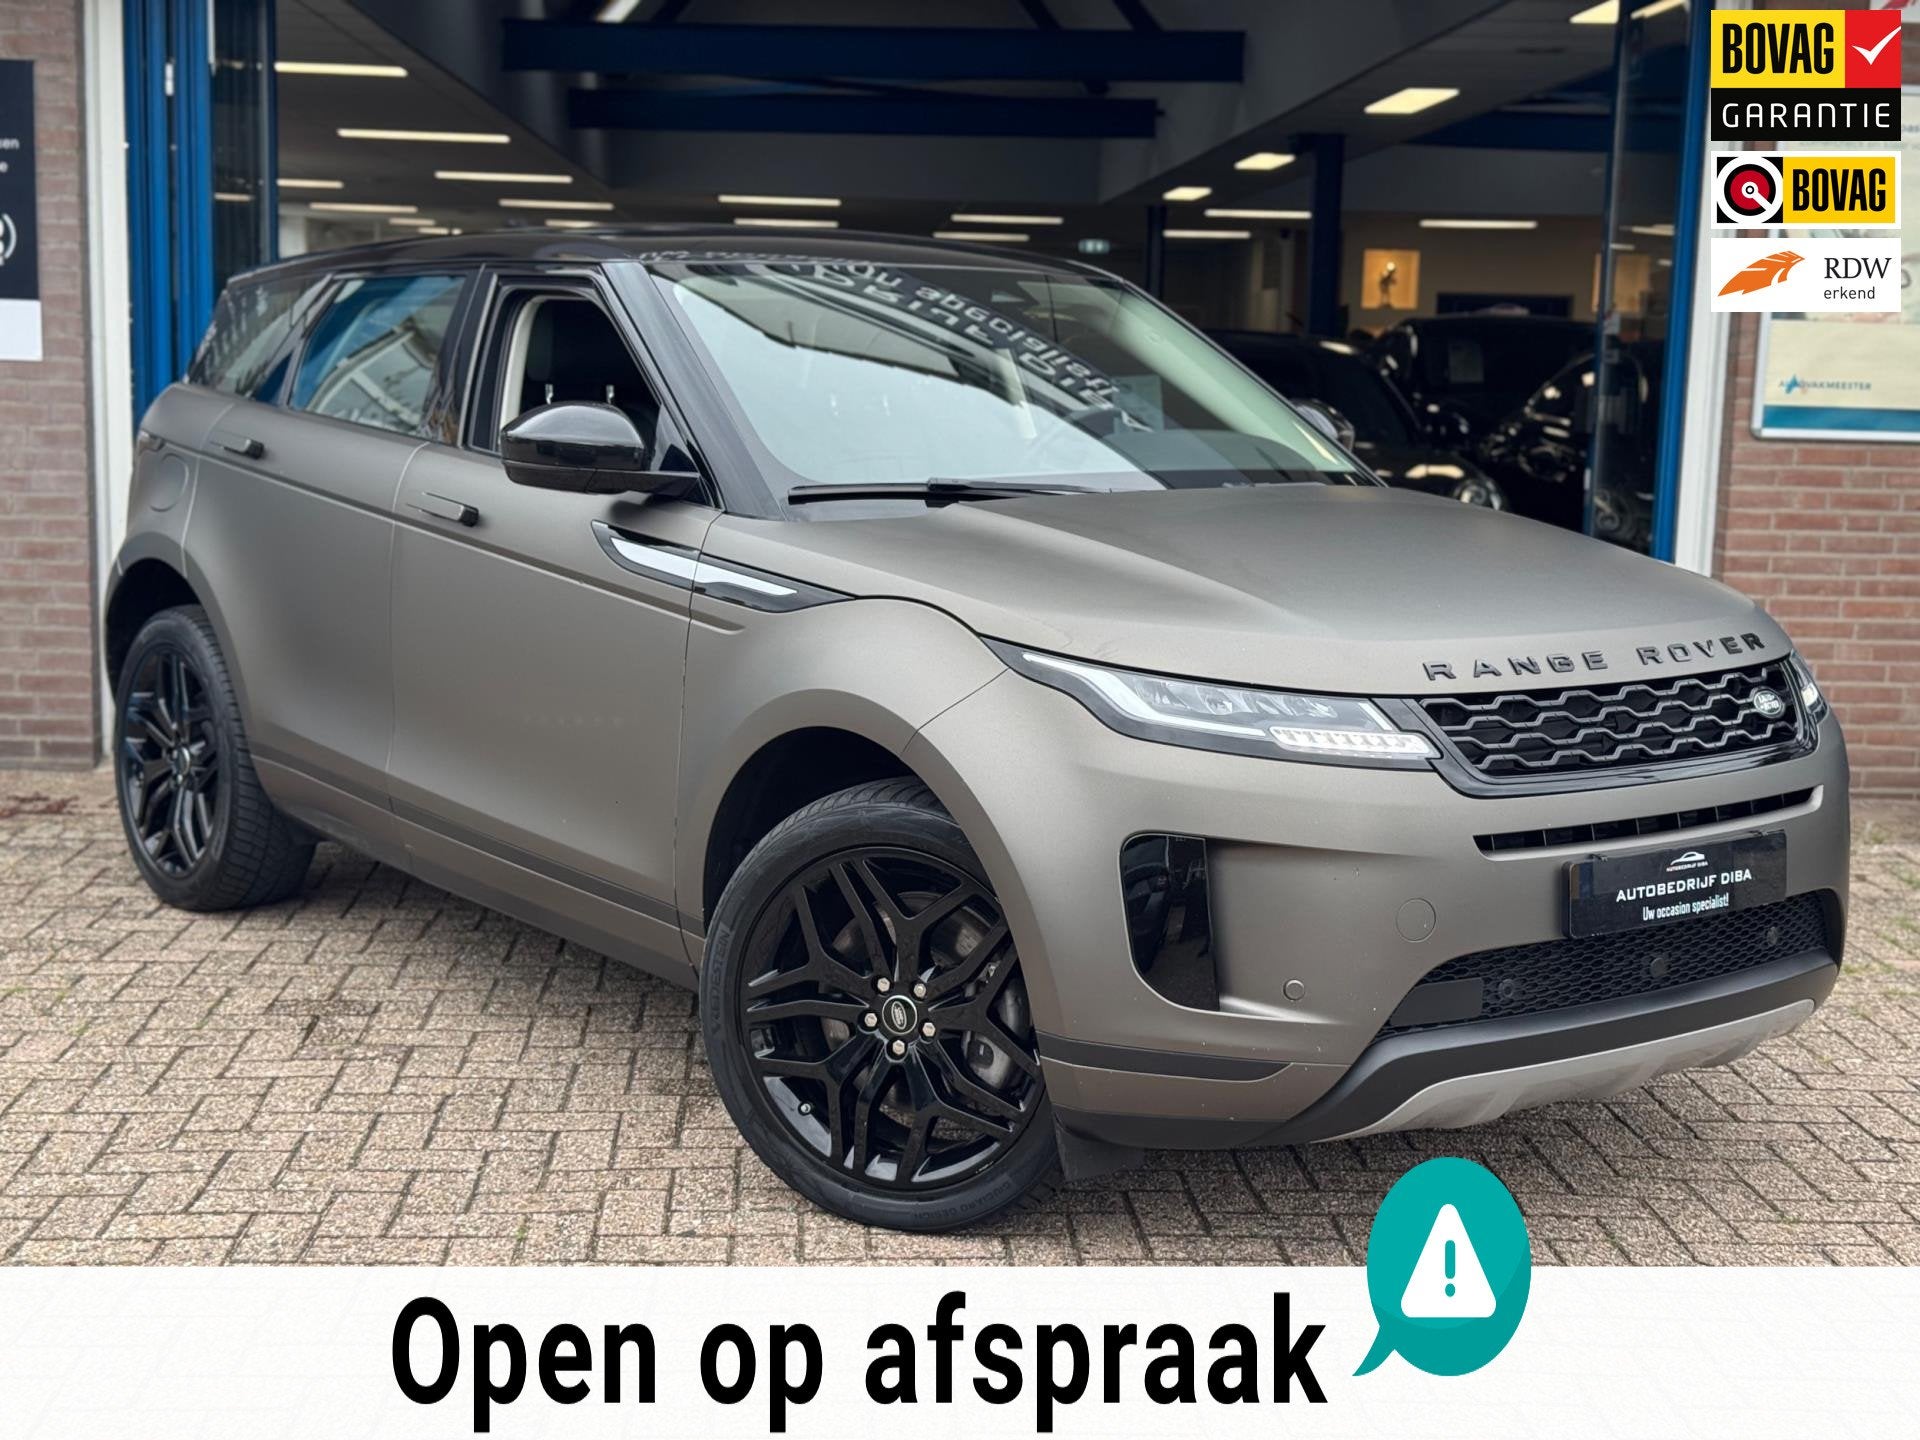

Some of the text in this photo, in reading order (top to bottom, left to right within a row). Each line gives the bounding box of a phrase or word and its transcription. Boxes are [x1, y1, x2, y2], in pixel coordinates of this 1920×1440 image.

[1421, 632, 1766, 682] RANGE ROVER
[1615, 868, 1753, 902] AUTOBEDRIJF DIBA
[1642, 892, 1730, 921] Uw occasion specialist!
